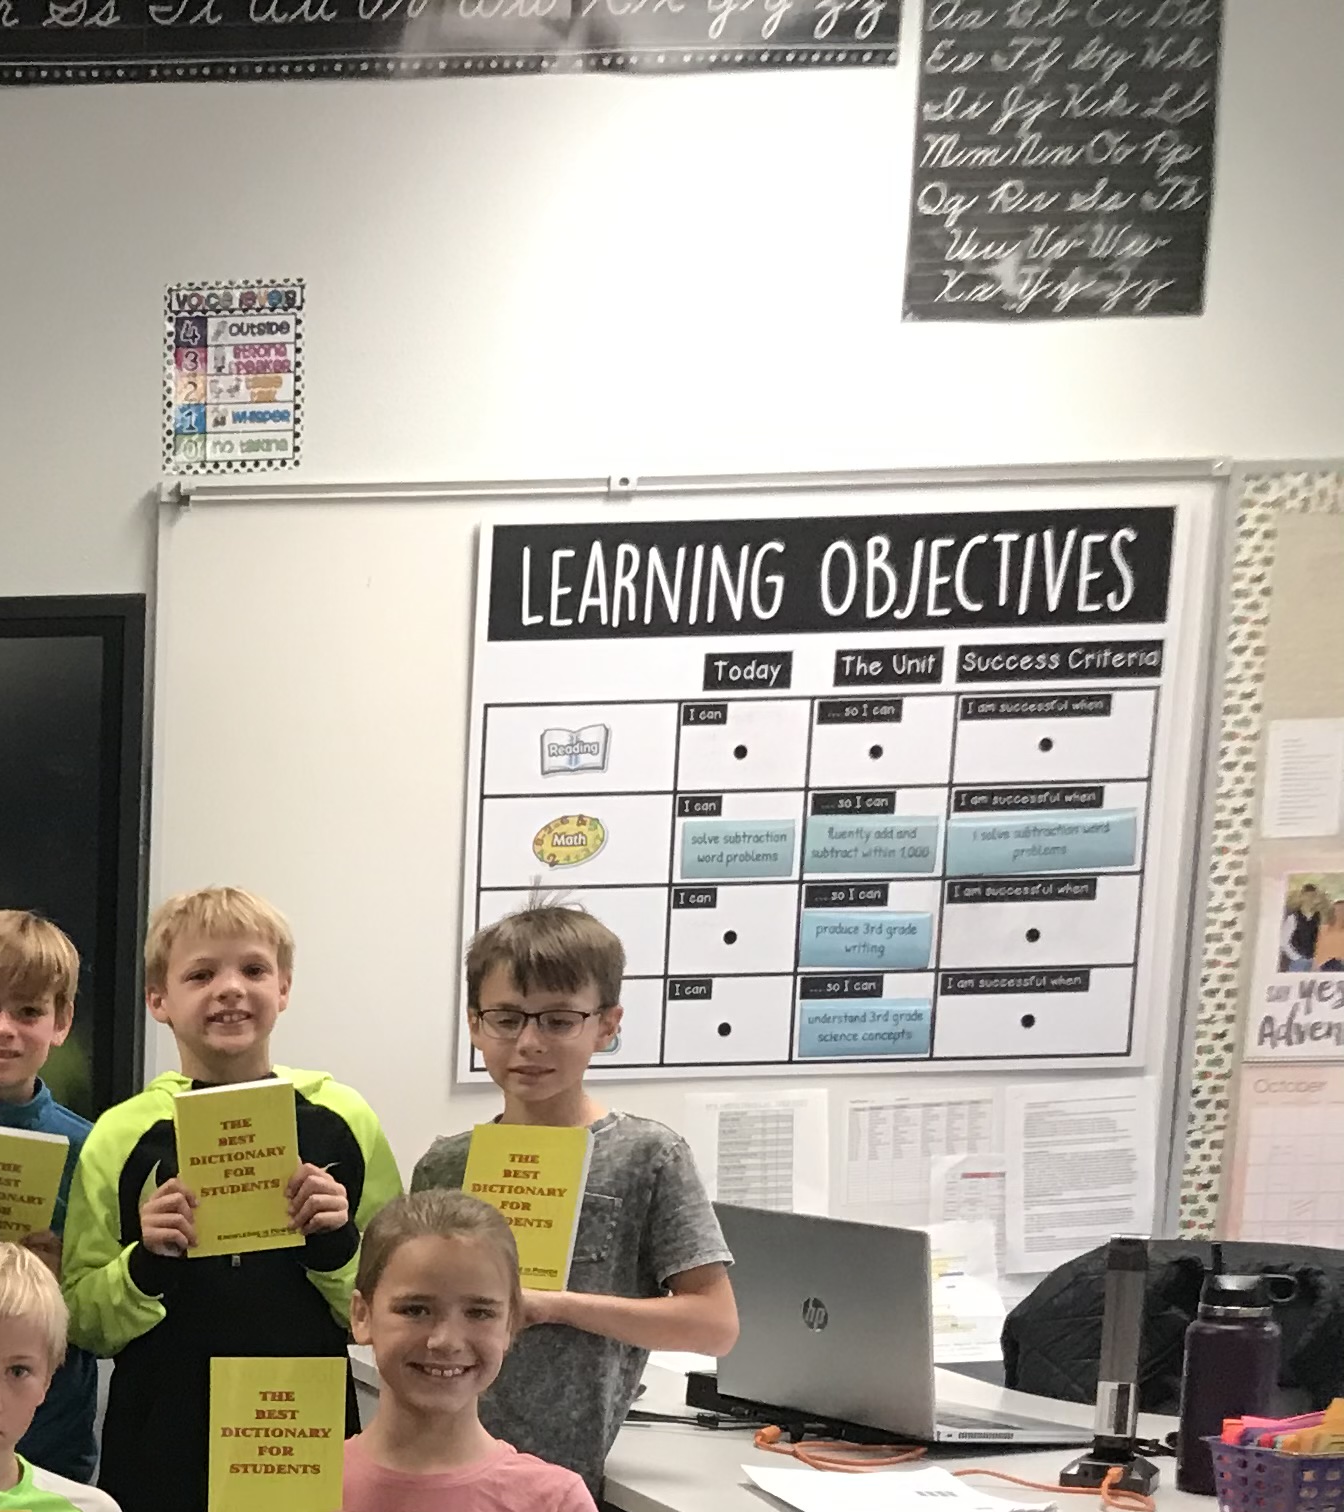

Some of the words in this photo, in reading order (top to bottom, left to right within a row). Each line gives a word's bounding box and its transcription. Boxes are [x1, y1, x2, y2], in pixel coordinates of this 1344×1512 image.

[180, 320, 200, 345] 4
[184, 350, 199, 371] 3
[183, 411, 198, 433] 1
[521, 540, 786, 626] LEARNING
[820, 526, 1138, 620] OBJECTIVES
[714, 660, 781, 684] Today
[842, 655, 883, 676] The
[893, 652, 936, 674] Unit
[962, 651, 1060, 672] Success
[1068, 647, 1160, 669] Criteria
[689, 709, 695, 720] I
[699, 709, 722, 720] can
[844, 707, 857, 716] so
[861, 704, 868, 716] I
[872, 704, 895, 715] can
[967, 703, 973, 714] I
[977, 702, 996, 713] am
[999, 700, 1068, 713] successful
[548, 741, 599, 757] Reading
[552, 832, 587, 847] Math
[692, 831, 719, 845] solve
[723, 831, 787, 845] subtraction
[697, 850, 723, 863] word
[726, 849, 778, 864] problems
[815, 924, 859, 938] produce
[863, 924, 883, 936] 3rd
[886, 923, 918, 939] grade
[845, 941, 885, 957] writing
[807, 1011, 866, 1025] understand
[869, 1011, 890, 1023] 3rd
[892, 1011, 923, 1025] grade
[818, 1030, 858, 1042] science
[862, 1027, 912, 1043] concepts
[805, 1297, 826, 1330] hp
[260, 1391, 295, 1402] THE
[255, 1409, 299, 1420] BEST
[221, 1428, 331, 1438] DICTIONARY
[257, 1446, 294, 1456] FOR
[229, 1464, 320, 1475] STUDENTS
